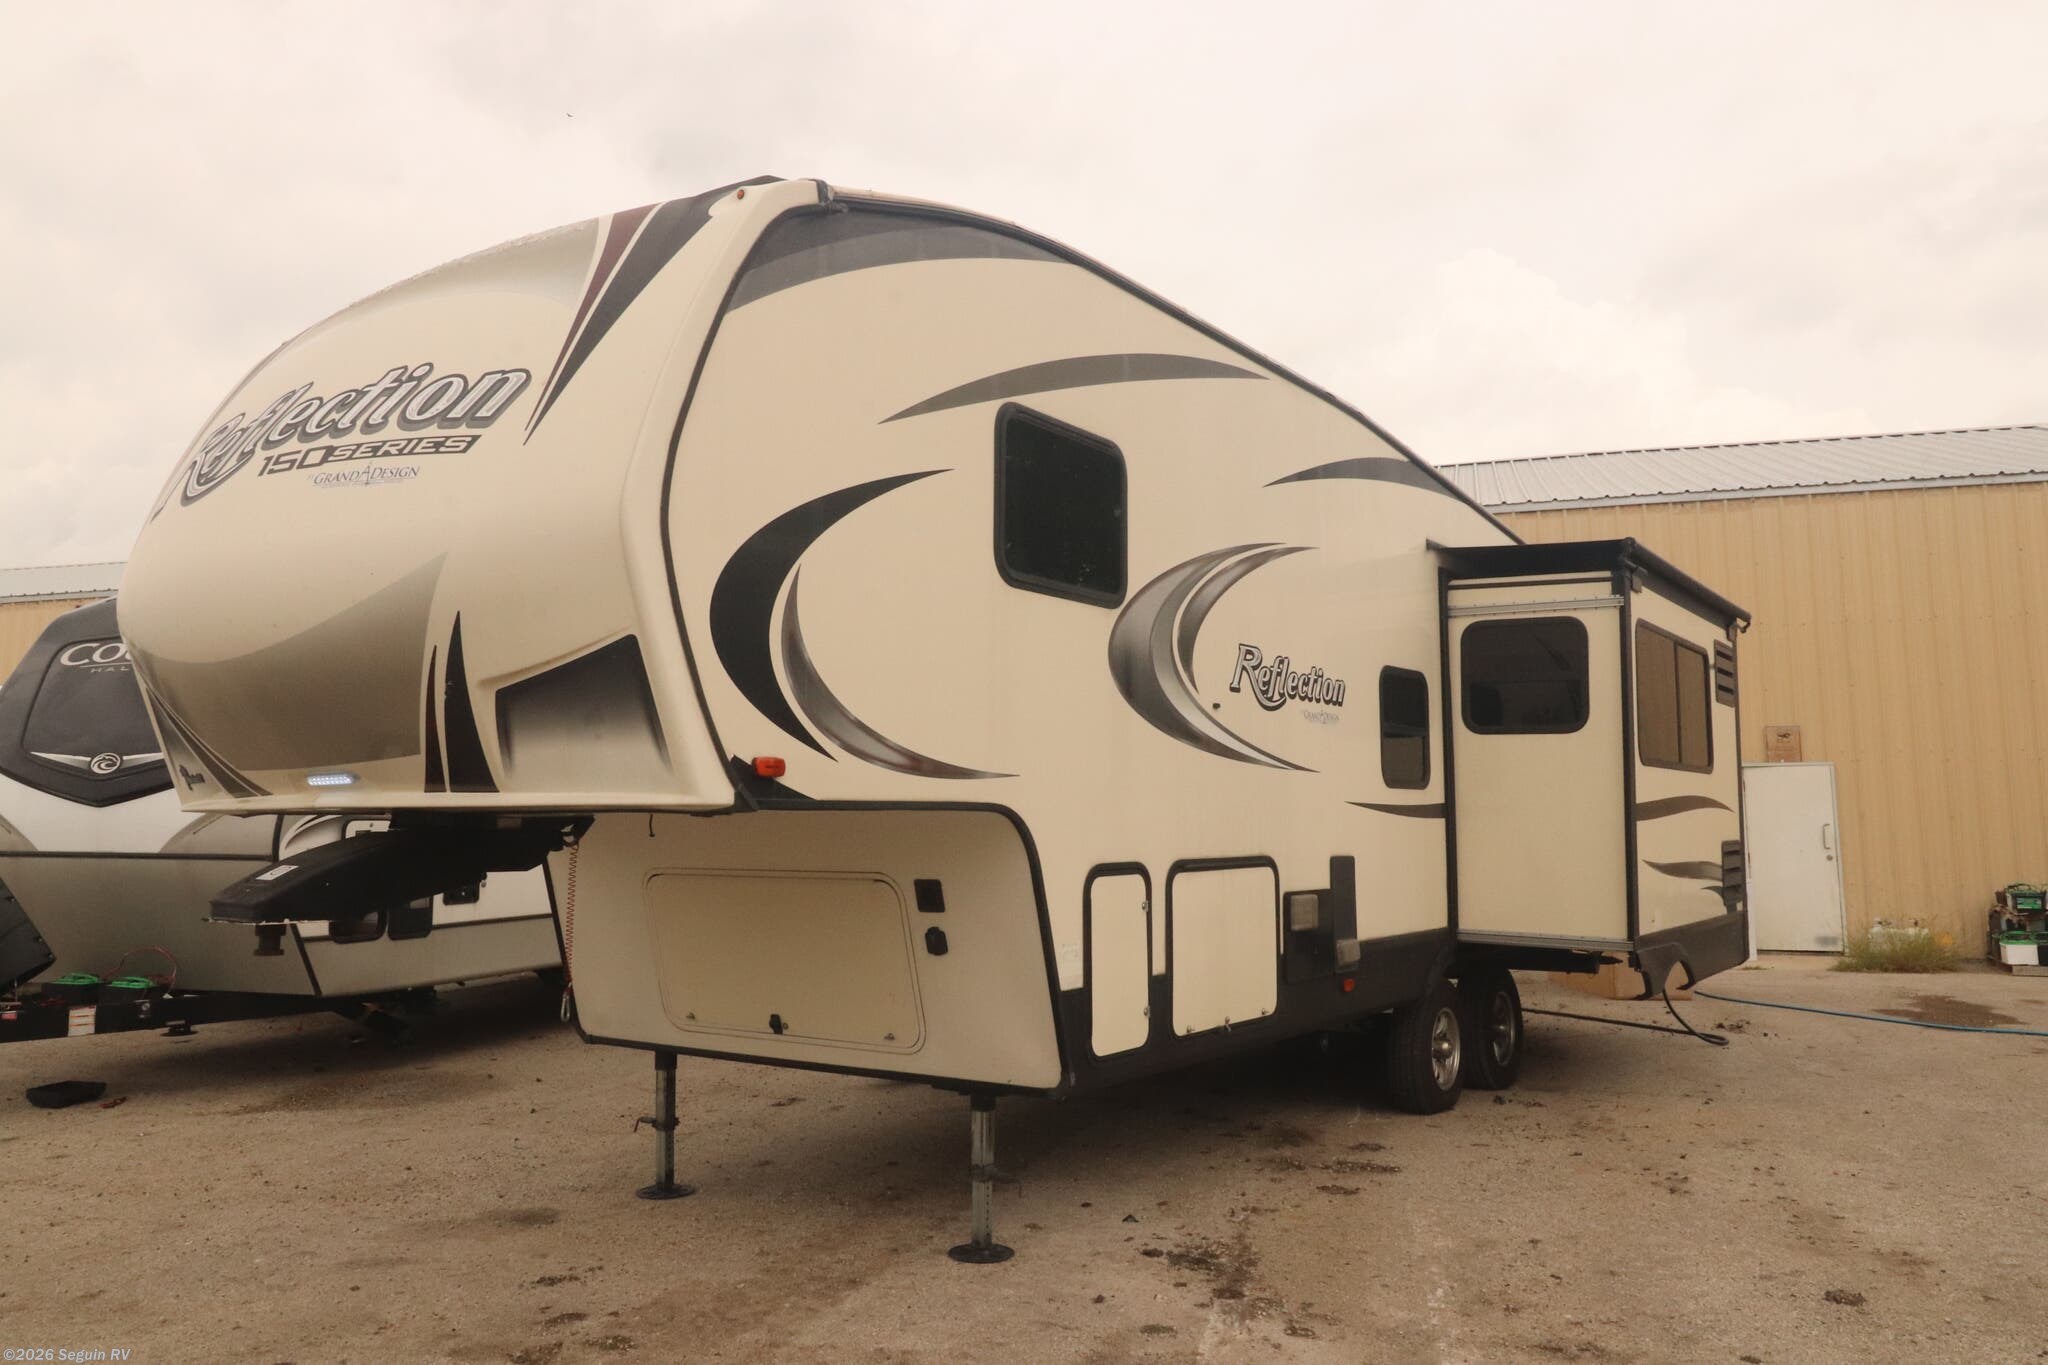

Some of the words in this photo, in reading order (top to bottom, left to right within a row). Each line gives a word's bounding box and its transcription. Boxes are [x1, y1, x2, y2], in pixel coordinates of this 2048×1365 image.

[258, 445, 332, 477] 150
[327, 435, 478, 461] SERIES
[313, 470, 360, 485] GRAND
[369, 464, 421, 480] DESIGN
[61, 643, 132, 666] CO
[1229, 643, 1346, 711] Reflection
